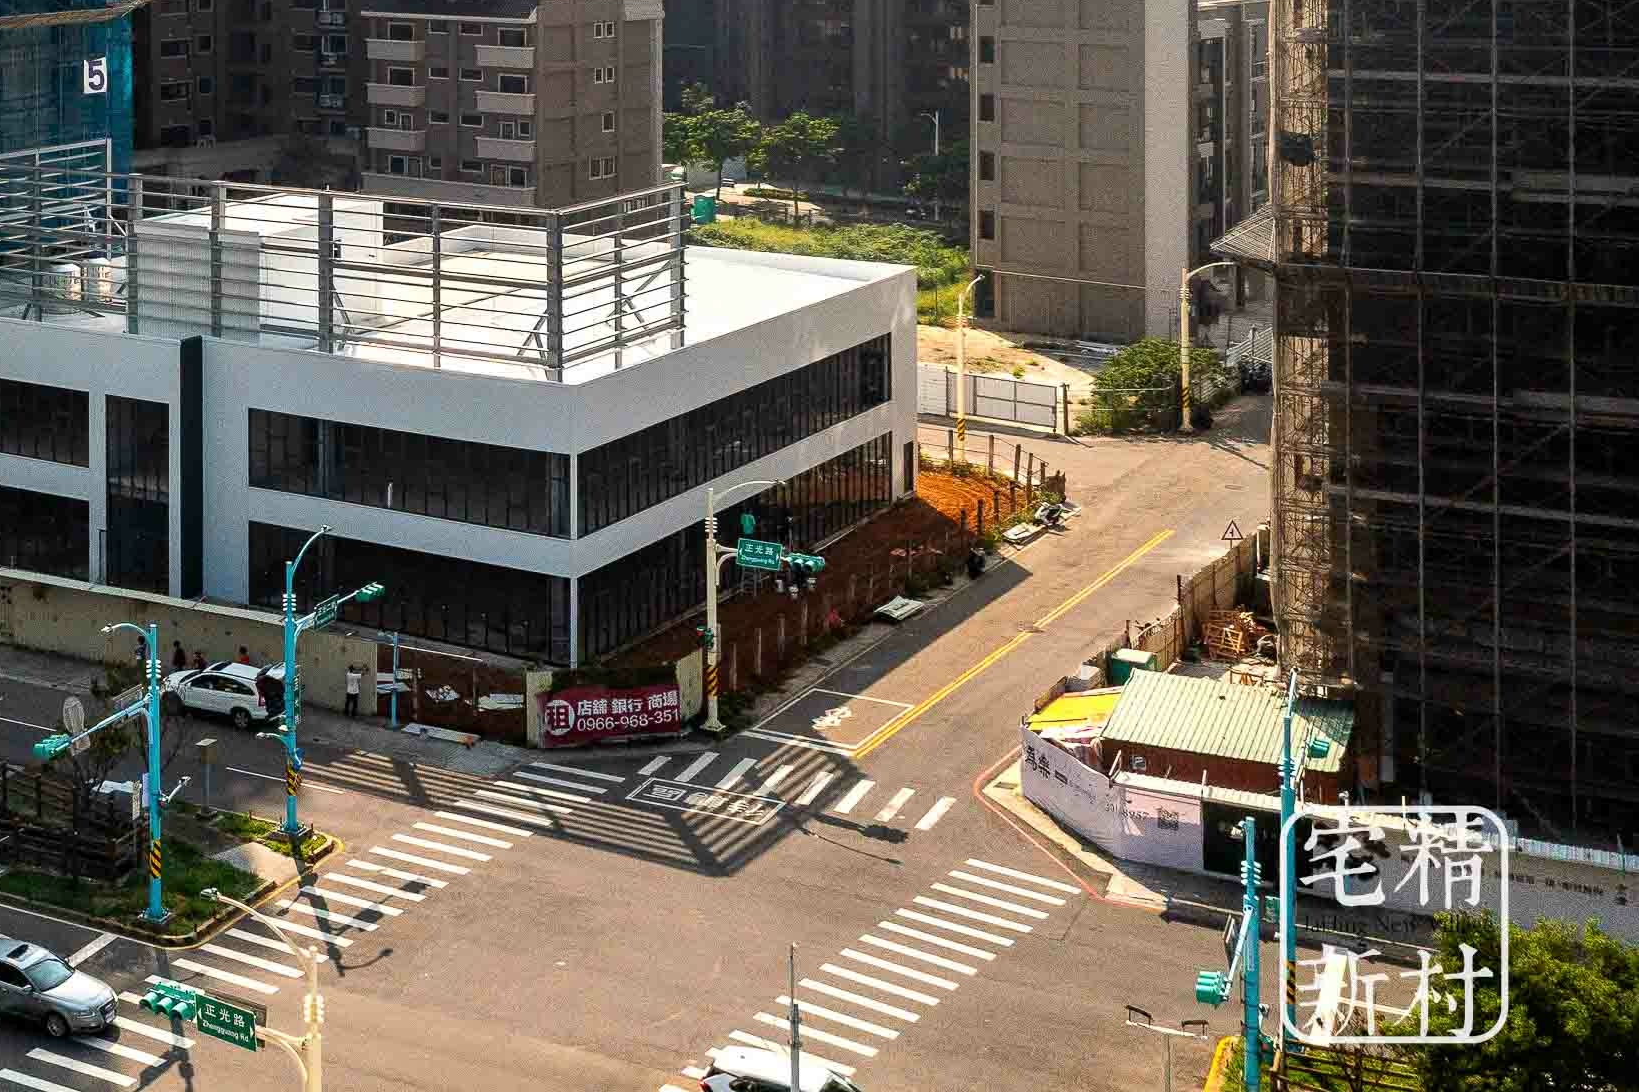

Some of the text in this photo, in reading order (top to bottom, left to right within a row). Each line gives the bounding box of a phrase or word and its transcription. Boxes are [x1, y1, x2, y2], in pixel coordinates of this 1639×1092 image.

[88, 60, 105, 91] 5
[611, 698, 643, 714] 銀行
[577, 708, 679, 731] 0966-968-351
[204, 1003, 245, 1028] 正光路
[202, 1019, 239, 1040] Zhengguang
